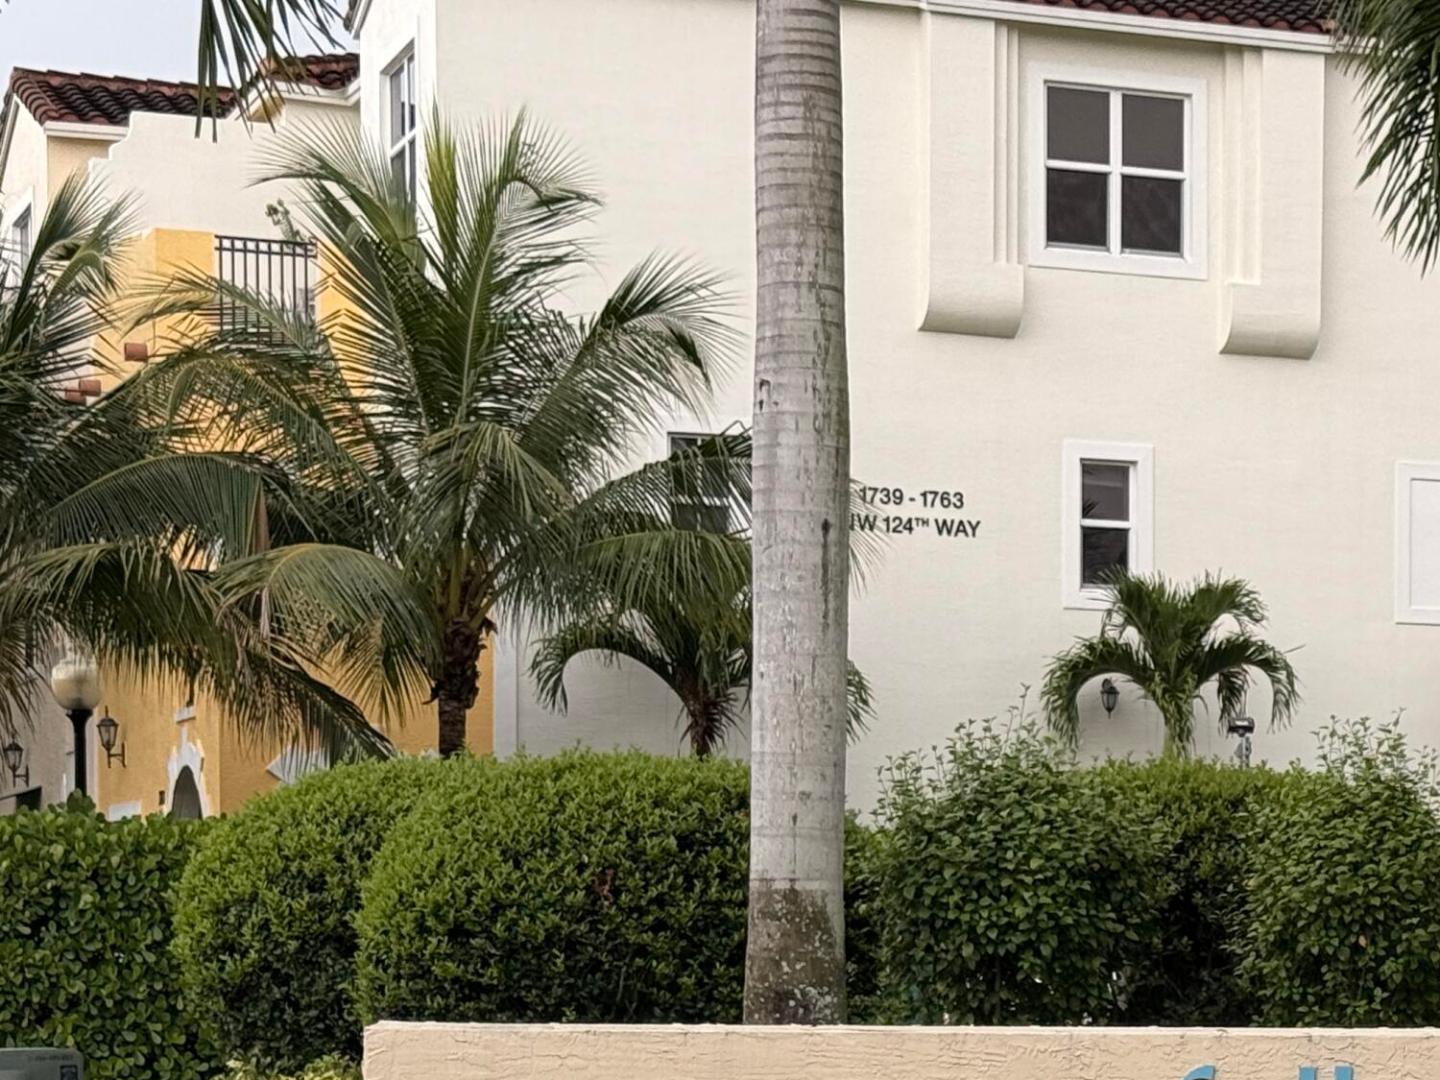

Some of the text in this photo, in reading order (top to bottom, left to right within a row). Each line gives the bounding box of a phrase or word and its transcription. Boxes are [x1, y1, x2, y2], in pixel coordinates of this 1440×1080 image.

[859, 486, 904, 506] 1739
[919, 490, 965, 509] 1763
[934, 517, 982, 538] WAY
